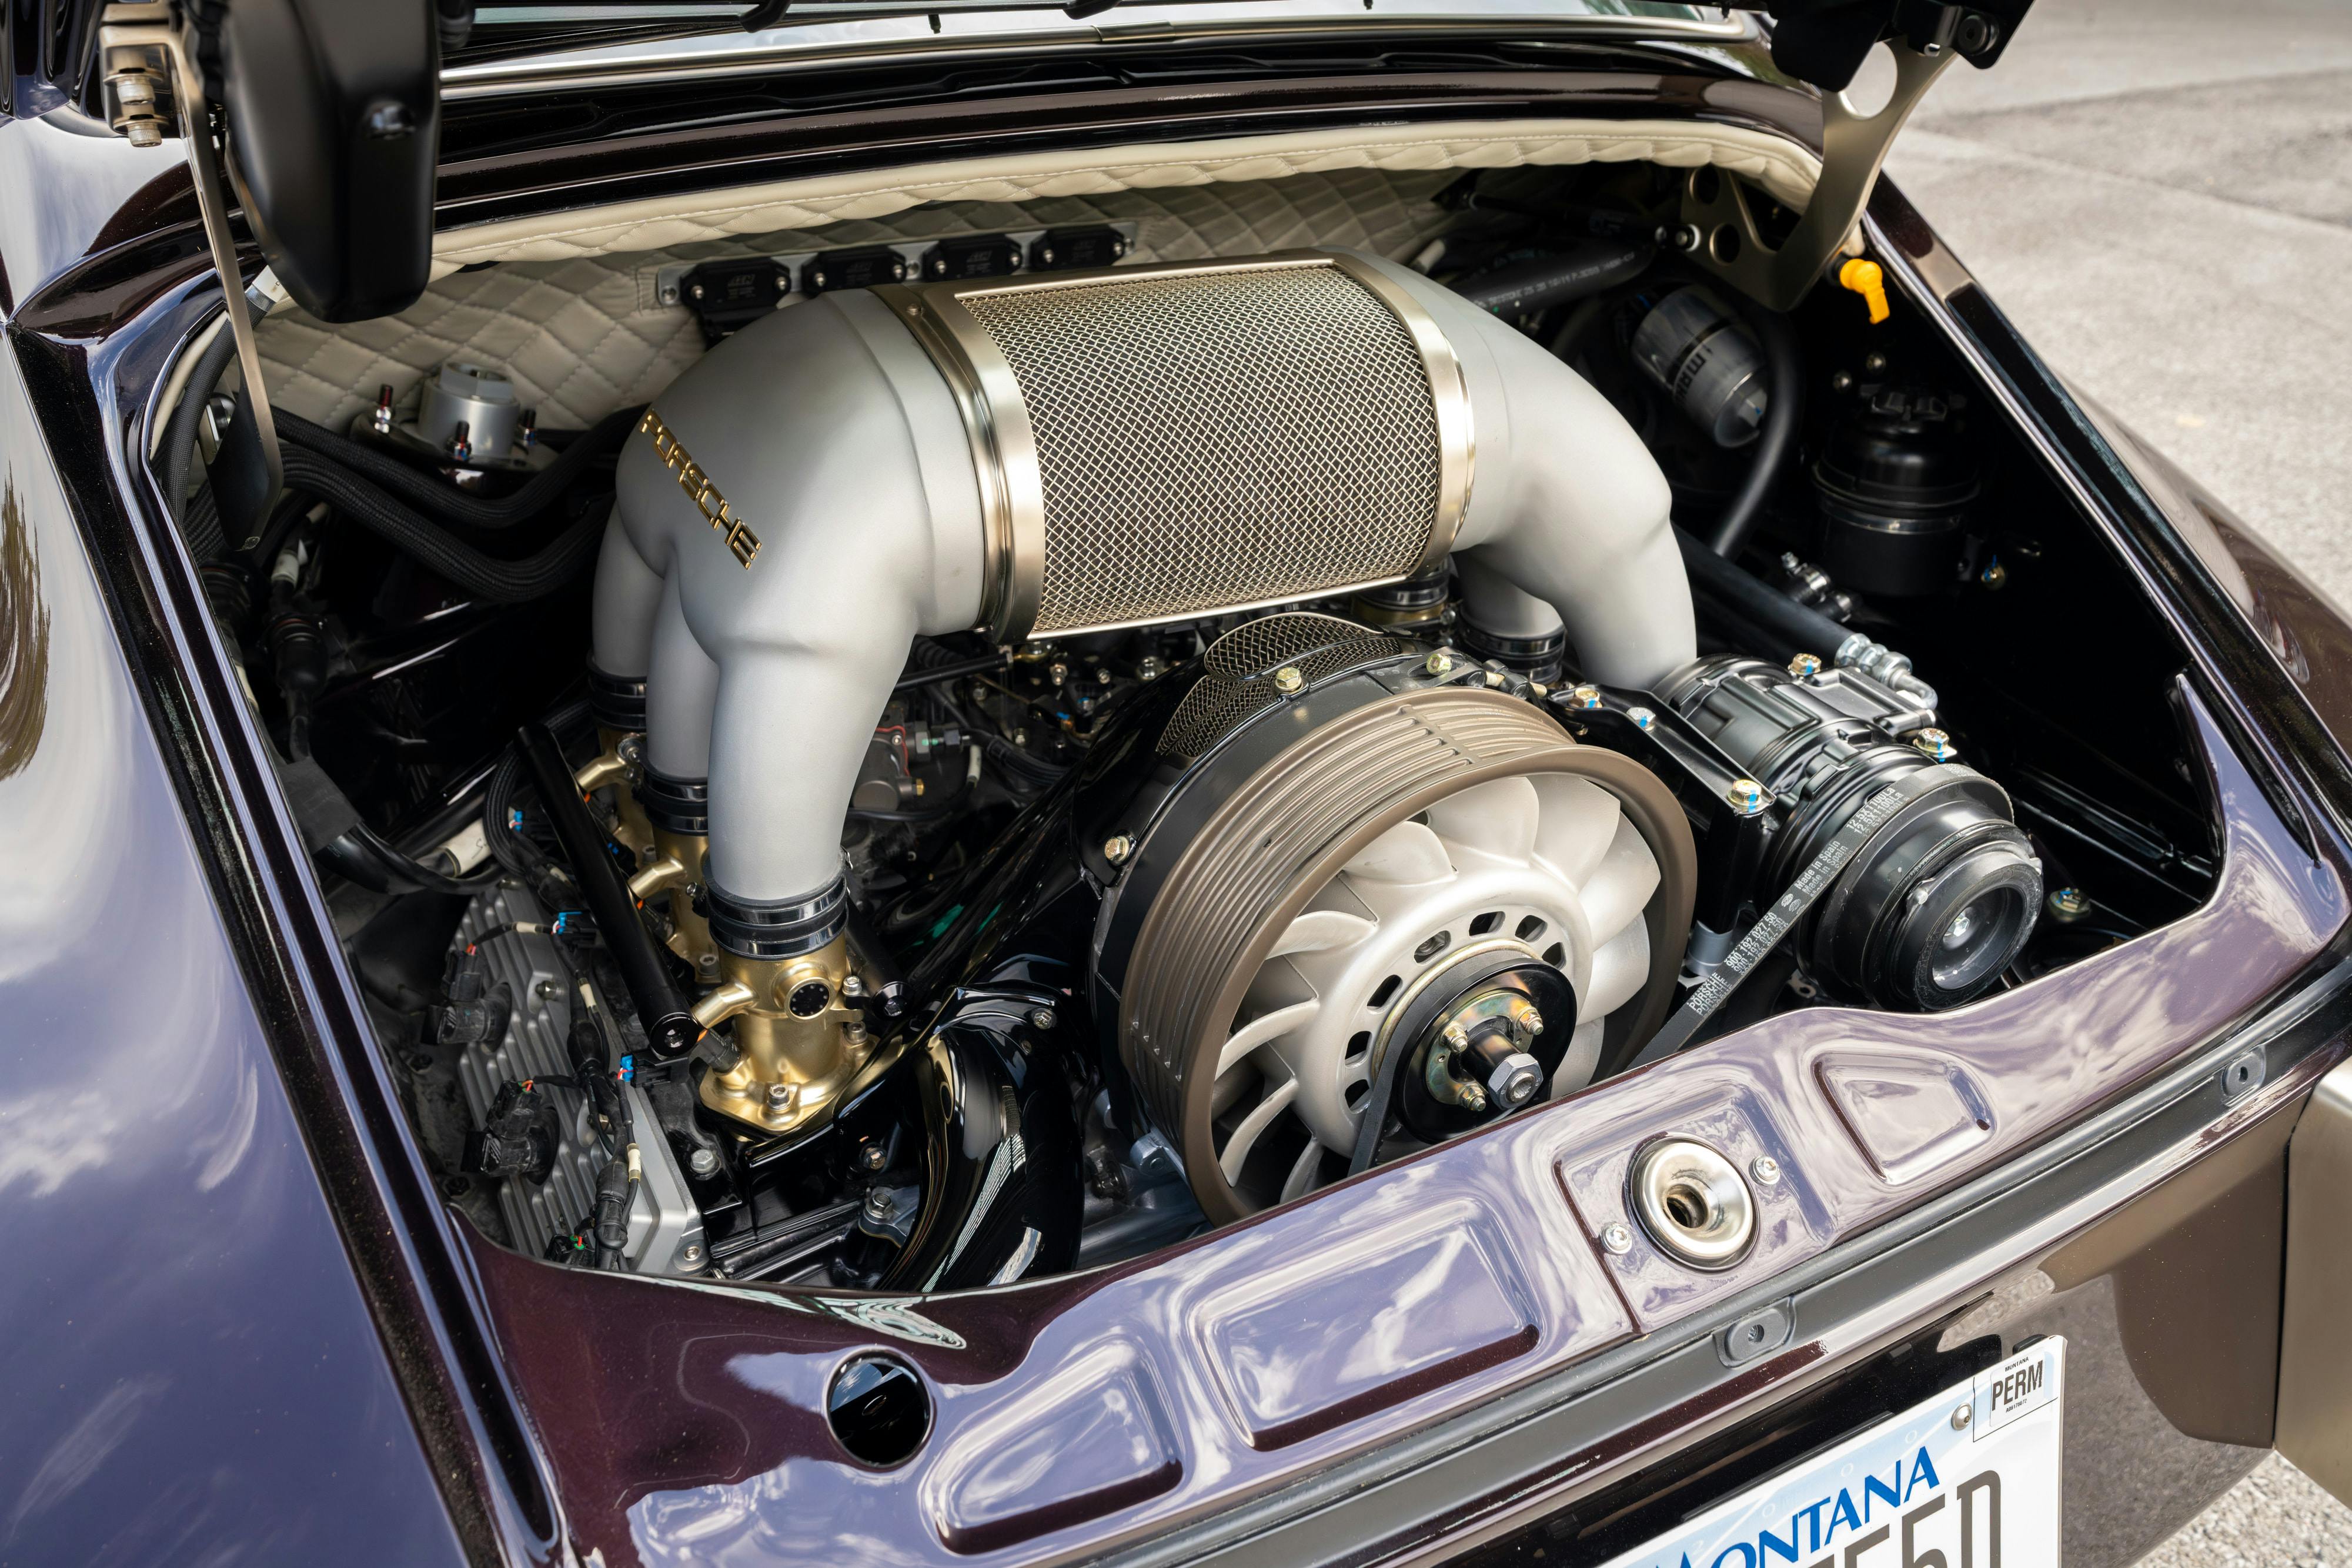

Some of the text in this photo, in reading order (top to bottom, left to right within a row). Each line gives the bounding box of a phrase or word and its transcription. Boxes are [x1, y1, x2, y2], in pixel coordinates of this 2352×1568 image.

[640, 409, 762, 570] PORSCHE
[1794, 841, 1840, 890] Made in Spain
[1689, 974, 1723, 1011] PORSCHE
[1992, 1360, 2043, 1412] PERM
[1655, 1446, 1940, 1568] ONTANA
